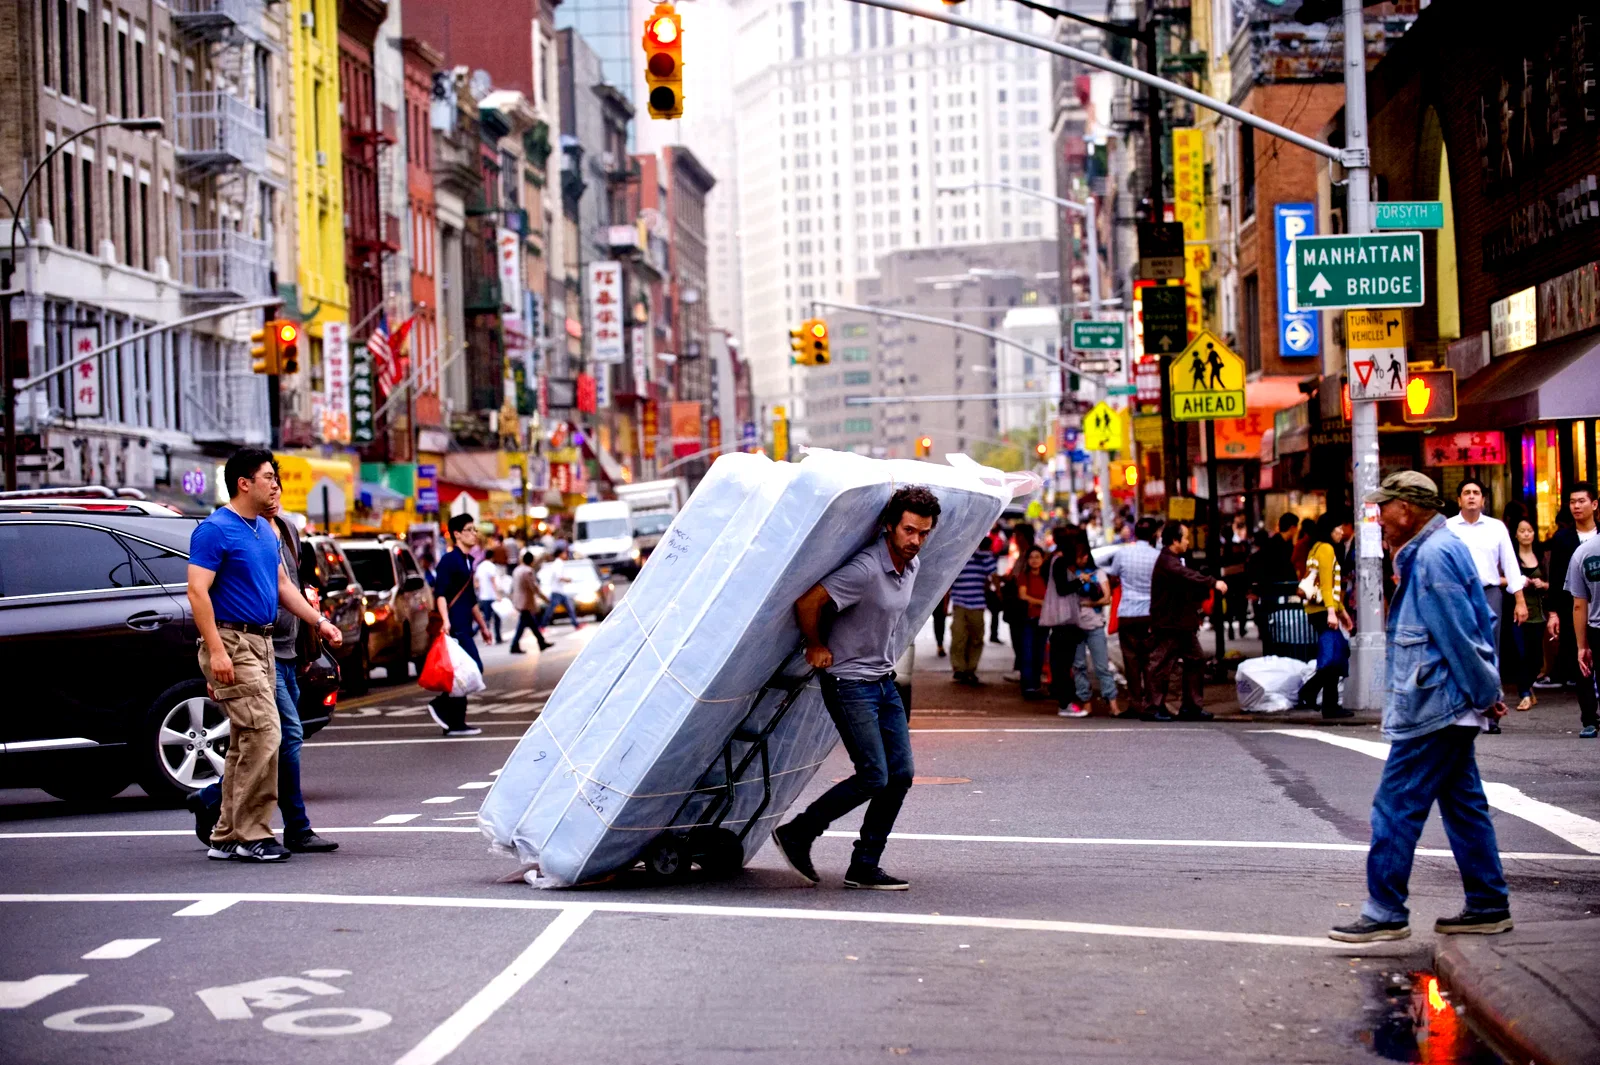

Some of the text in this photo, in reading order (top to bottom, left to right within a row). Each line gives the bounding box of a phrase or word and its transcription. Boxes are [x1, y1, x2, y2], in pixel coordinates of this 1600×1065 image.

[1377, 204, 1428, 219] FORSYTH
[1304, 245, 1415, 266] MANHATTAN
[1347, 276, 1413, 296] BRIDGE
[1350, 314, 1384, 326] TURNING
[1352, 330, 1384, 342] VEHICLES
[1183, 396, 1235, 414] AHEAD
